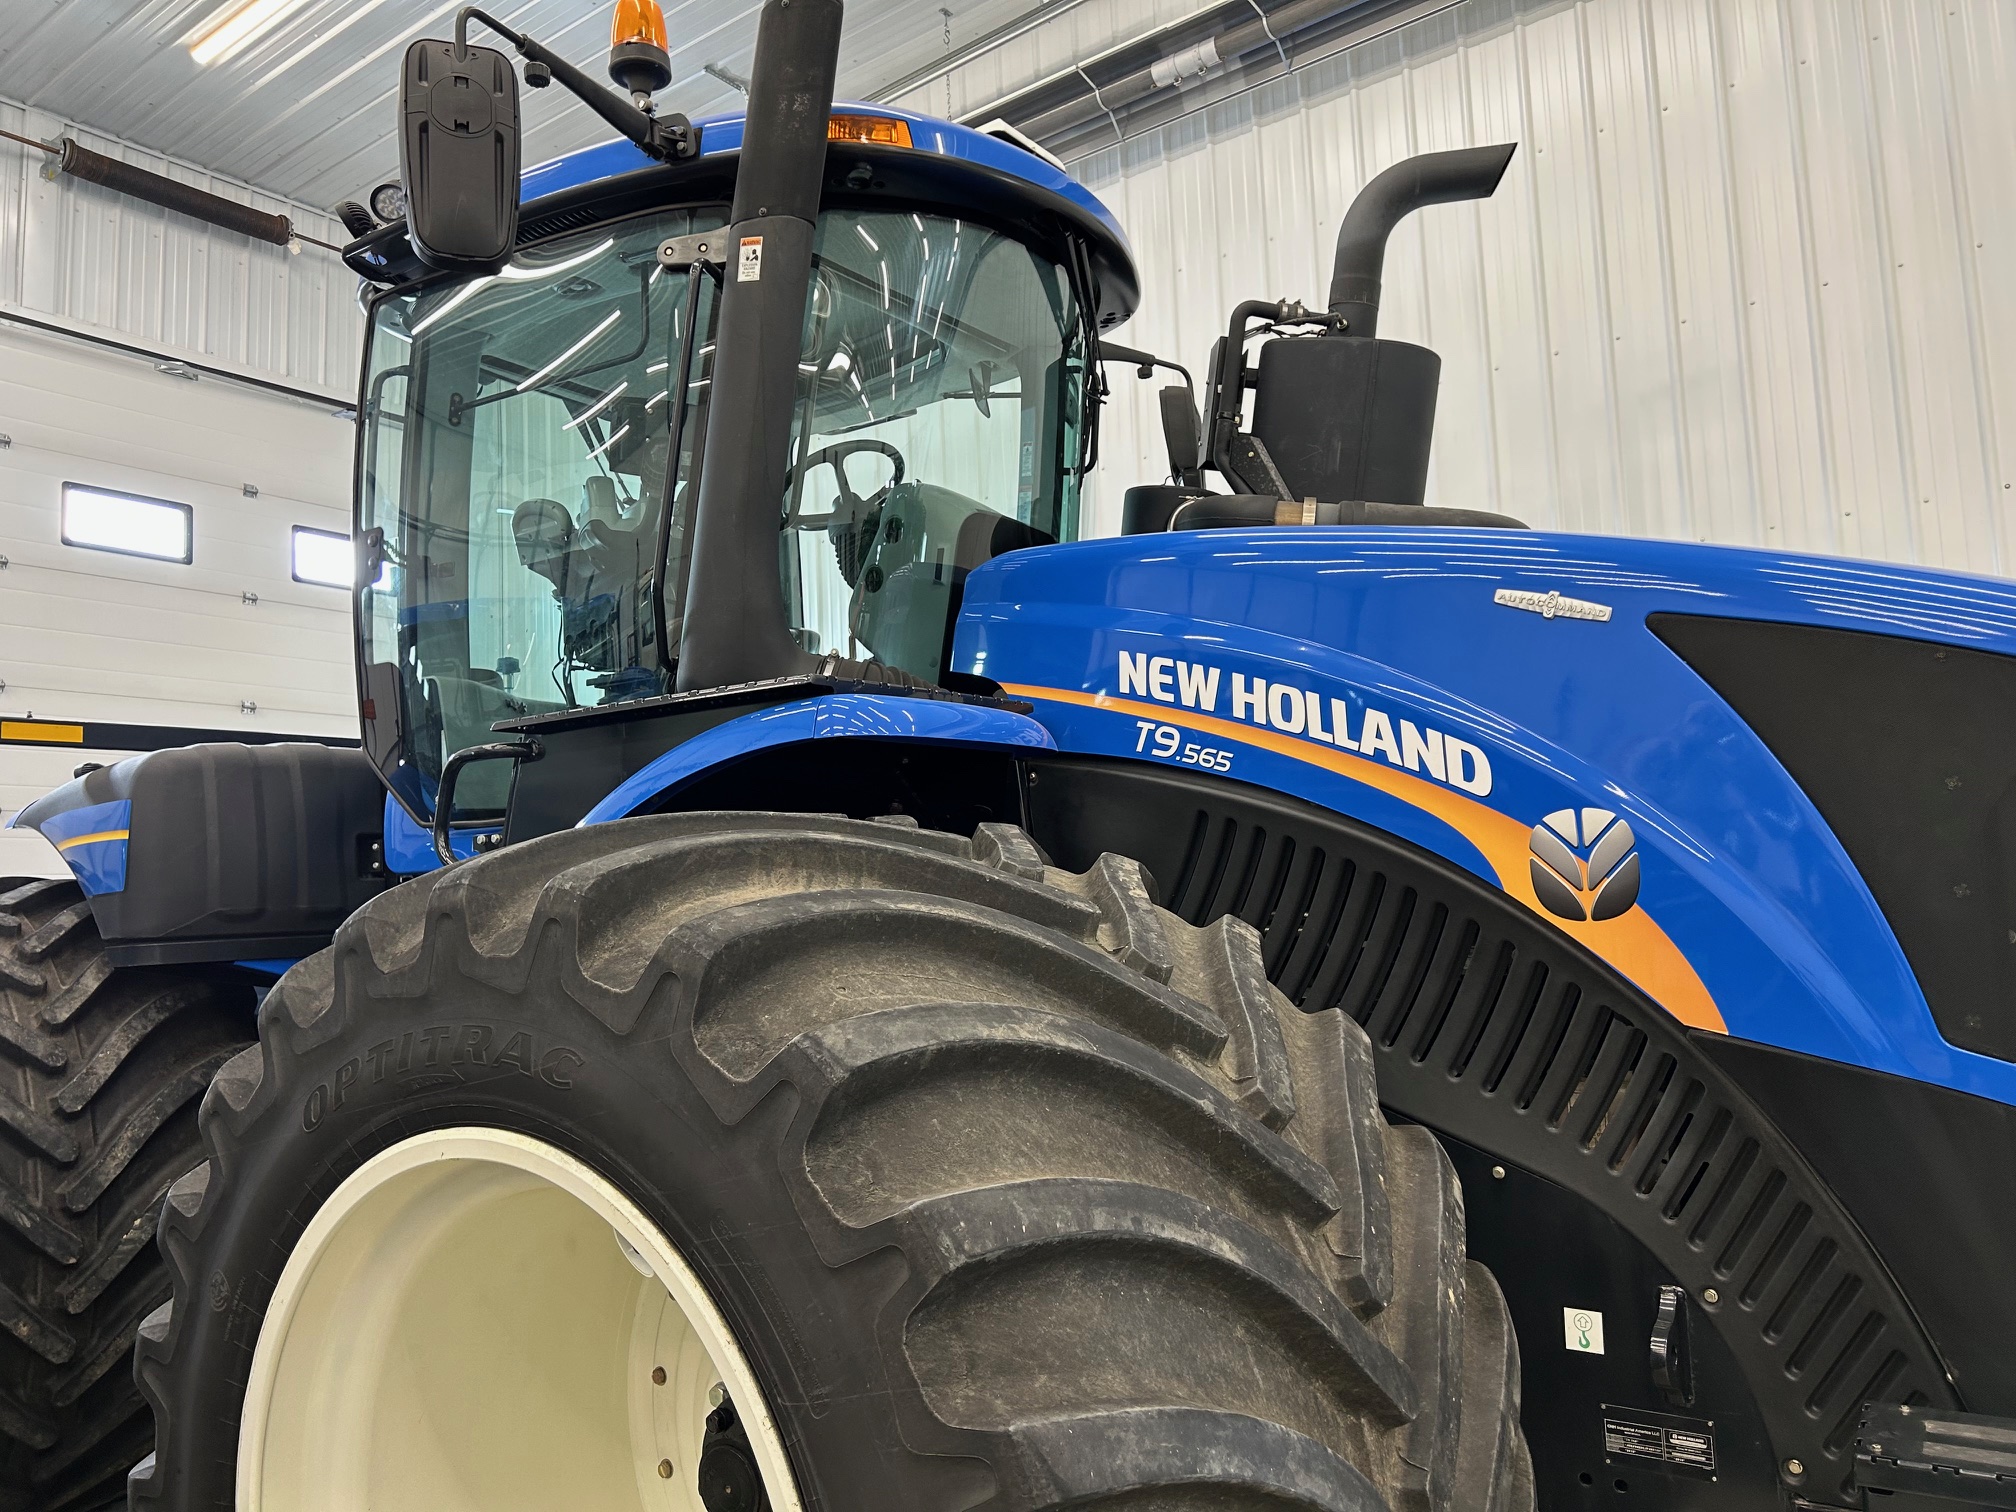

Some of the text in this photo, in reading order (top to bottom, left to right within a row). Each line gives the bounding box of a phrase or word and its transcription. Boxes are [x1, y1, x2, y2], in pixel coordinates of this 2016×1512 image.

[1497, 592, 1607, 618] AUTOCOMMAND
[1118, 650, 1493, 797] NEW HOLLAND
[1135, 721, 1234, 772] T9.565
[301, 1024, 585, 1133] OPTITRAC
